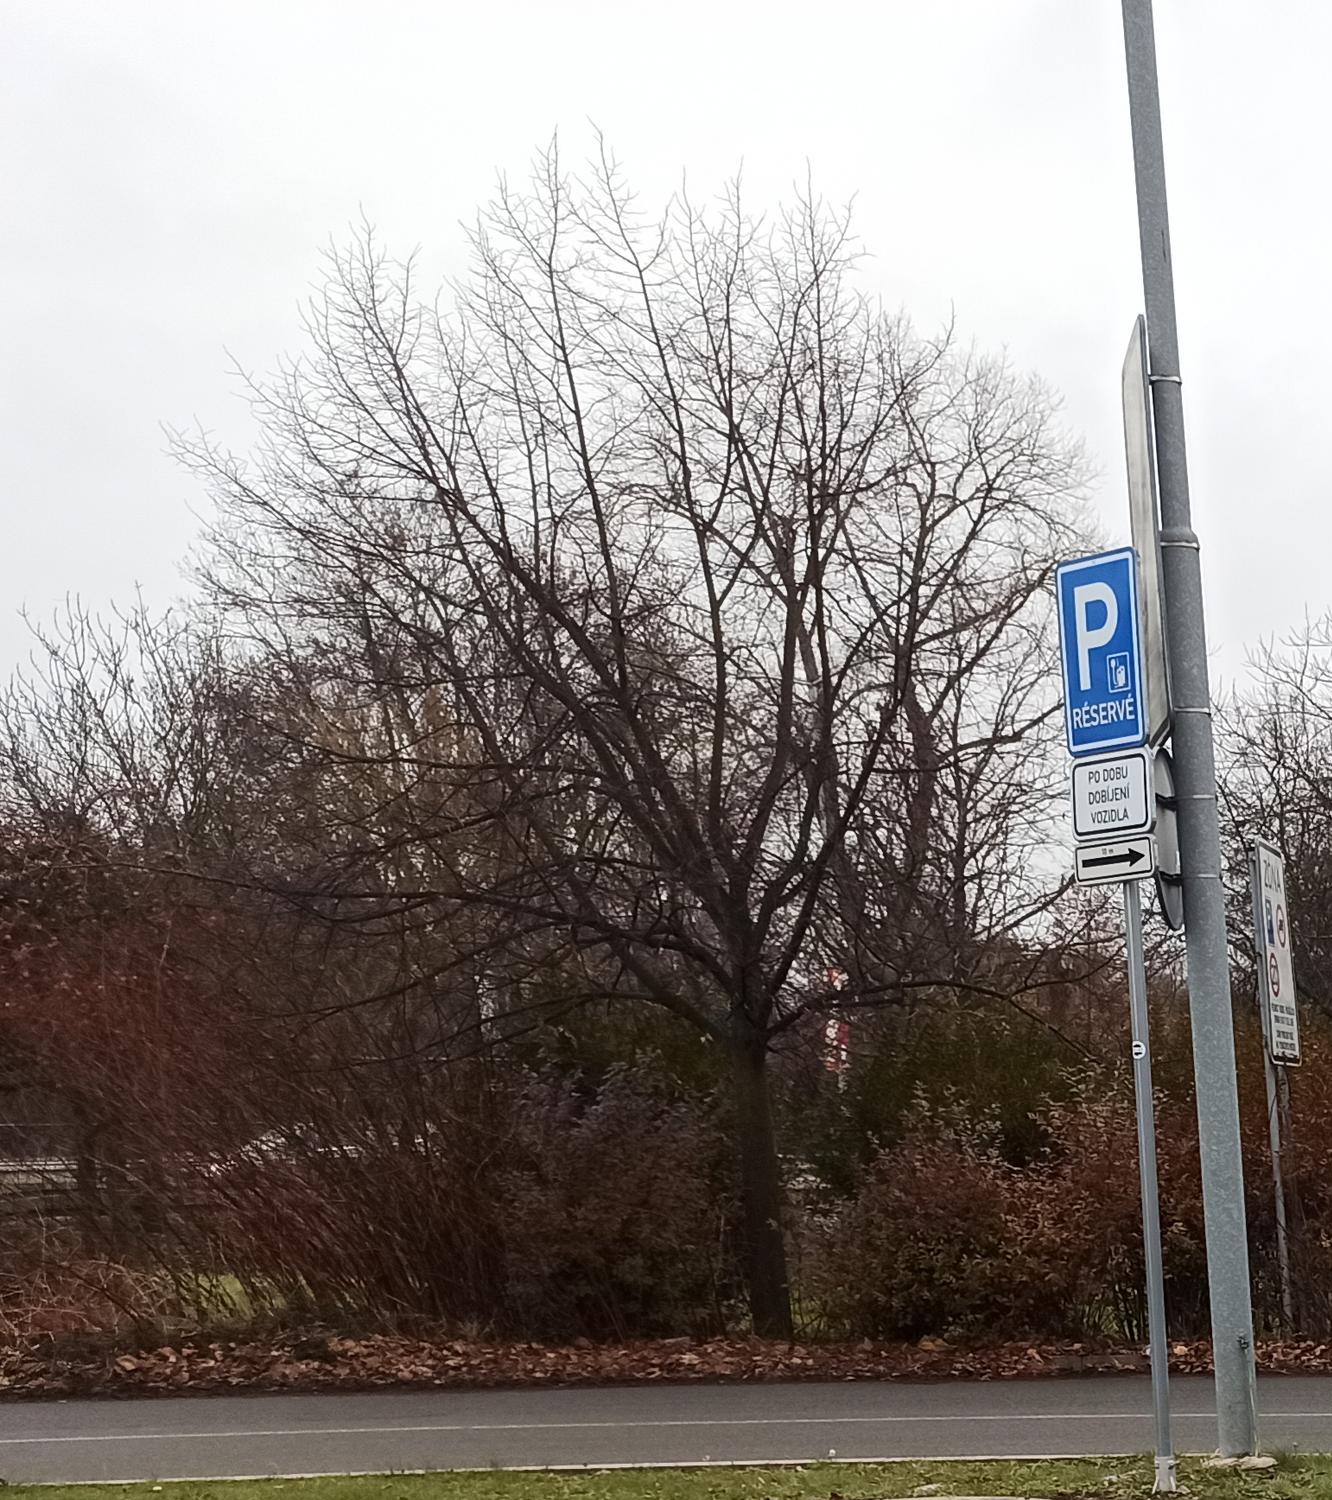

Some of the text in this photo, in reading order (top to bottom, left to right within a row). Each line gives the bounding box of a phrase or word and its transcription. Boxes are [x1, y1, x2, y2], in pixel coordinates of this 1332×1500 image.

[1074, 582, 1118, 691] P
[1073, 693, 1135, 729] RÉSERVÉ
[1088, 766, 1128, 783] PO DOBU
[1088, 783, 1130, 805] DOBÍJENÍ
[1090, 808, 1129, 823] VOZIDLA
